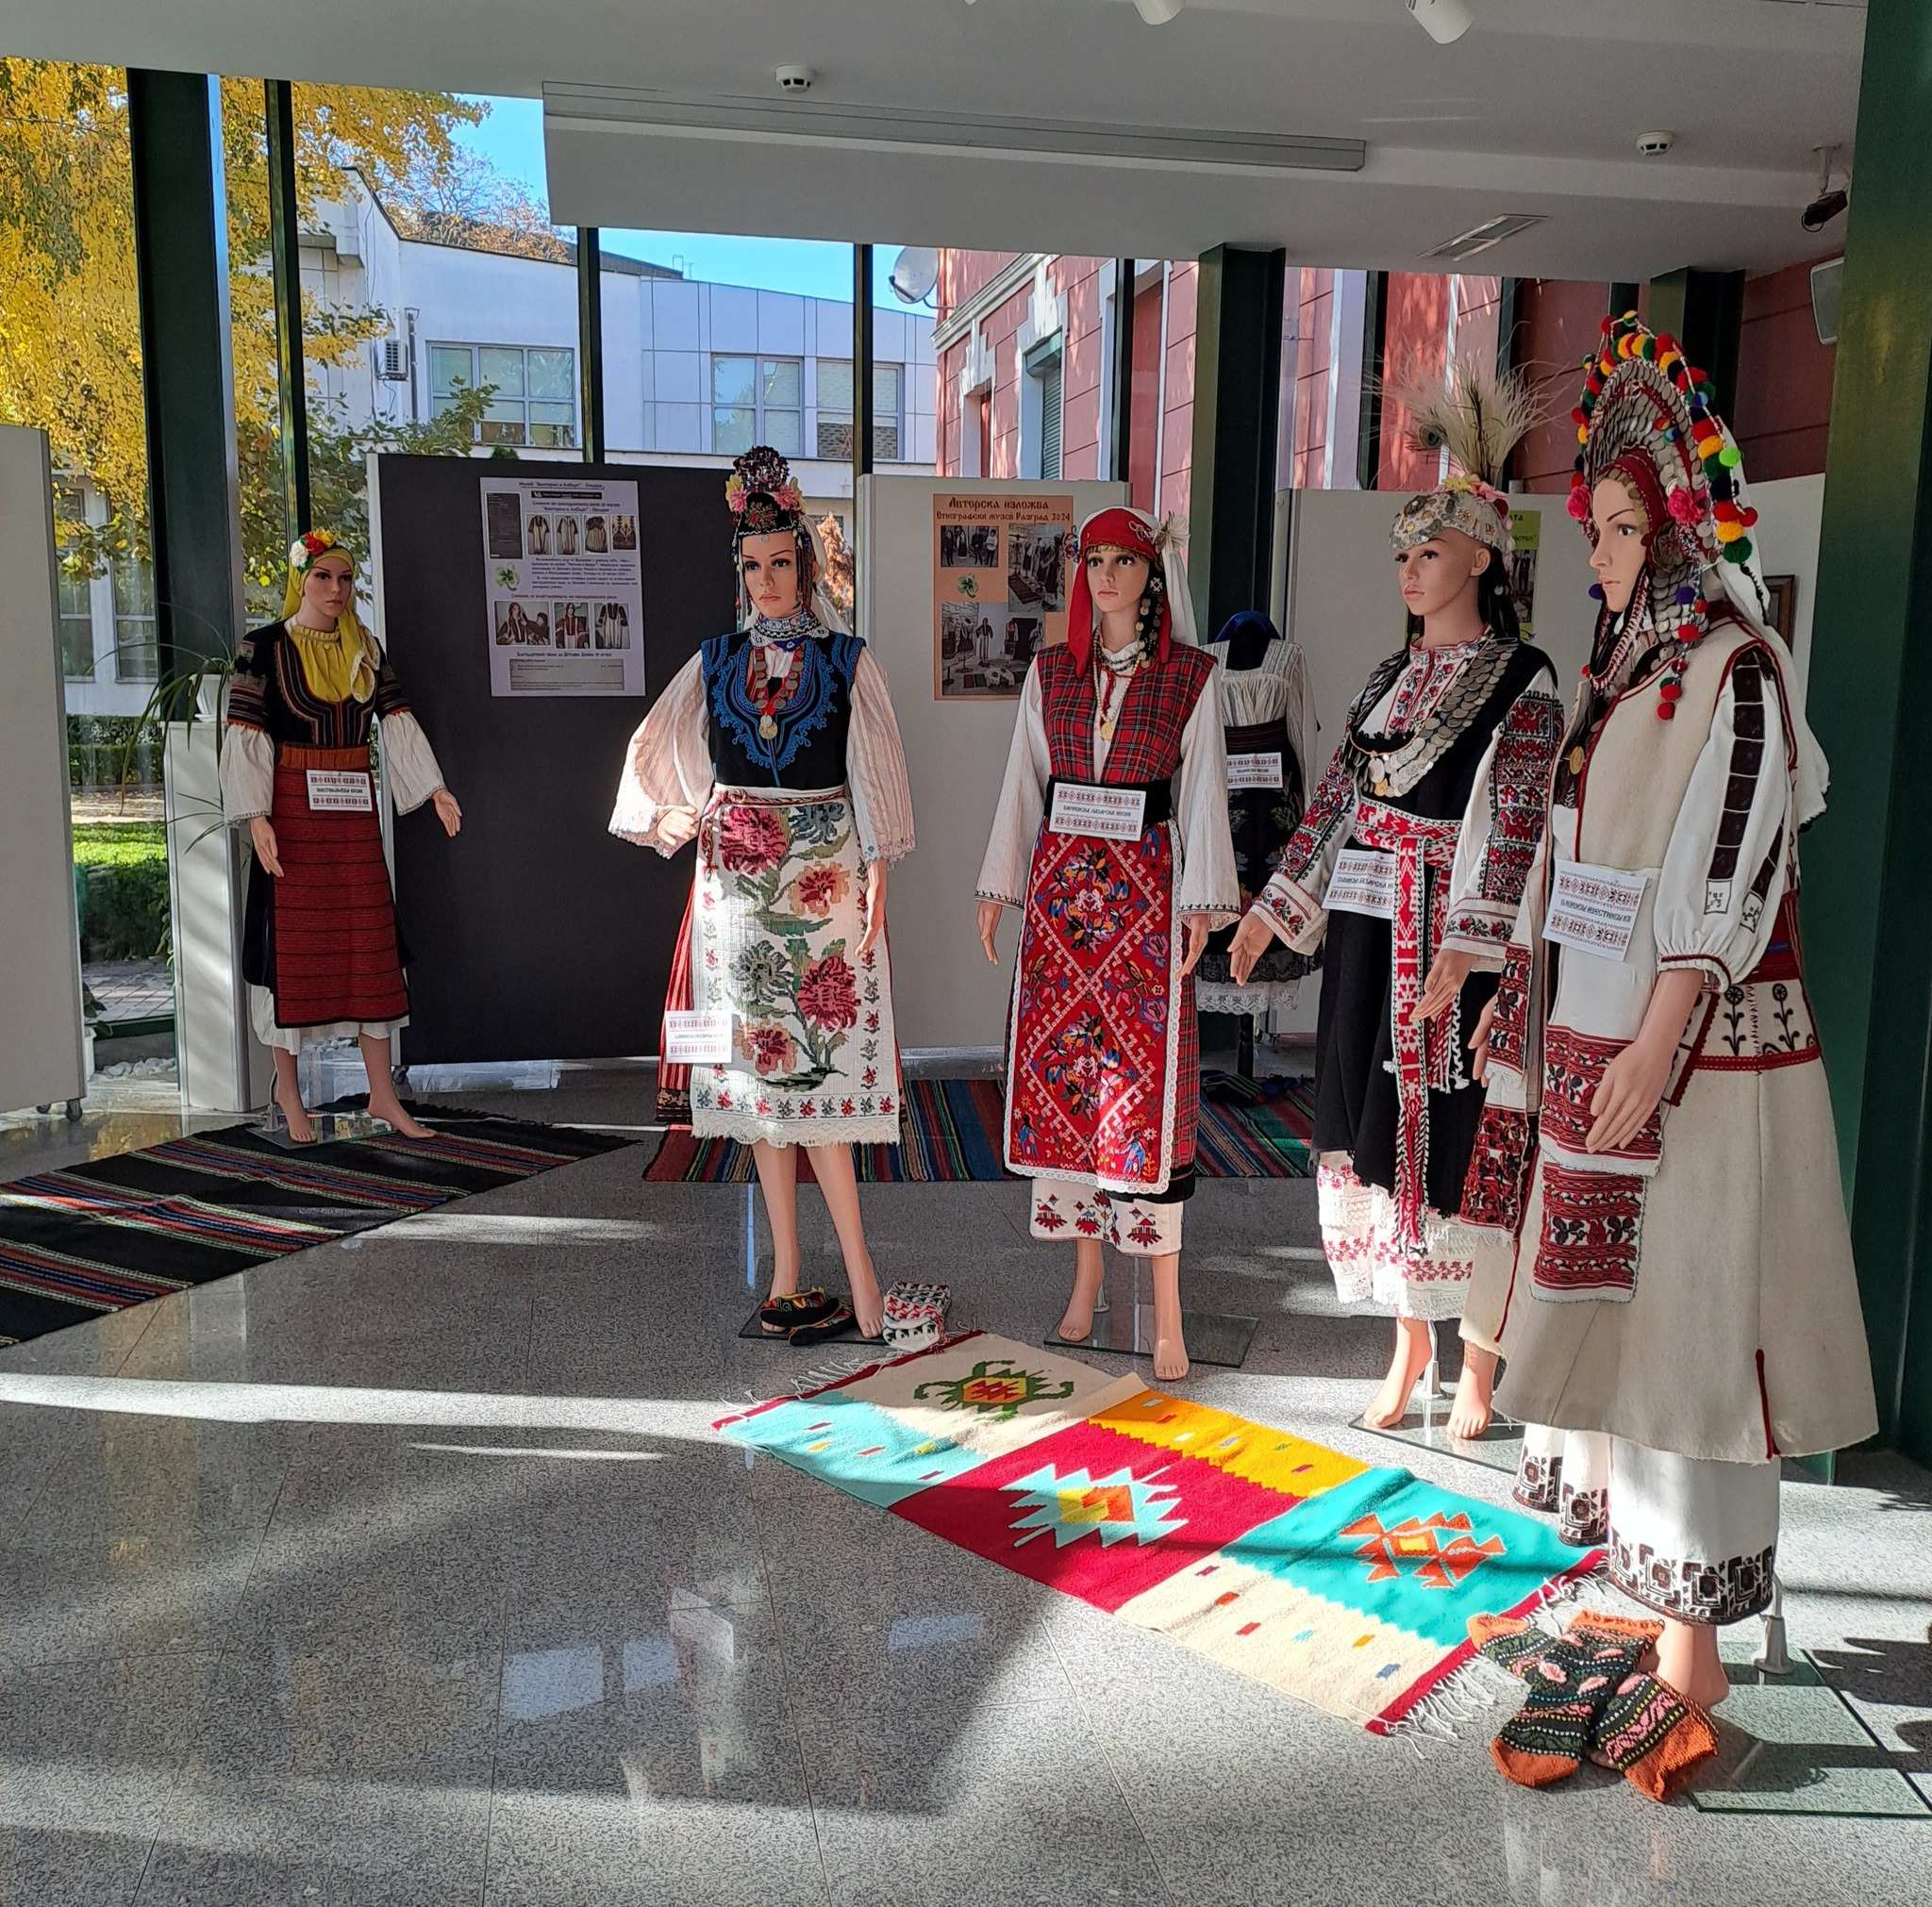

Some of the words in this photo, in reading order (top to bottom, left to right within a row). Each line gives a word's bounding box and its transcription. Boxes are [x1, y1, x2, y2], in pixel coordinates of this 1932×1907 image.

[949, 497, 1000, 511] Авторска
[1004, 500, 1049, 510] изложба
[1051, 512, 1071, 522] 2024
